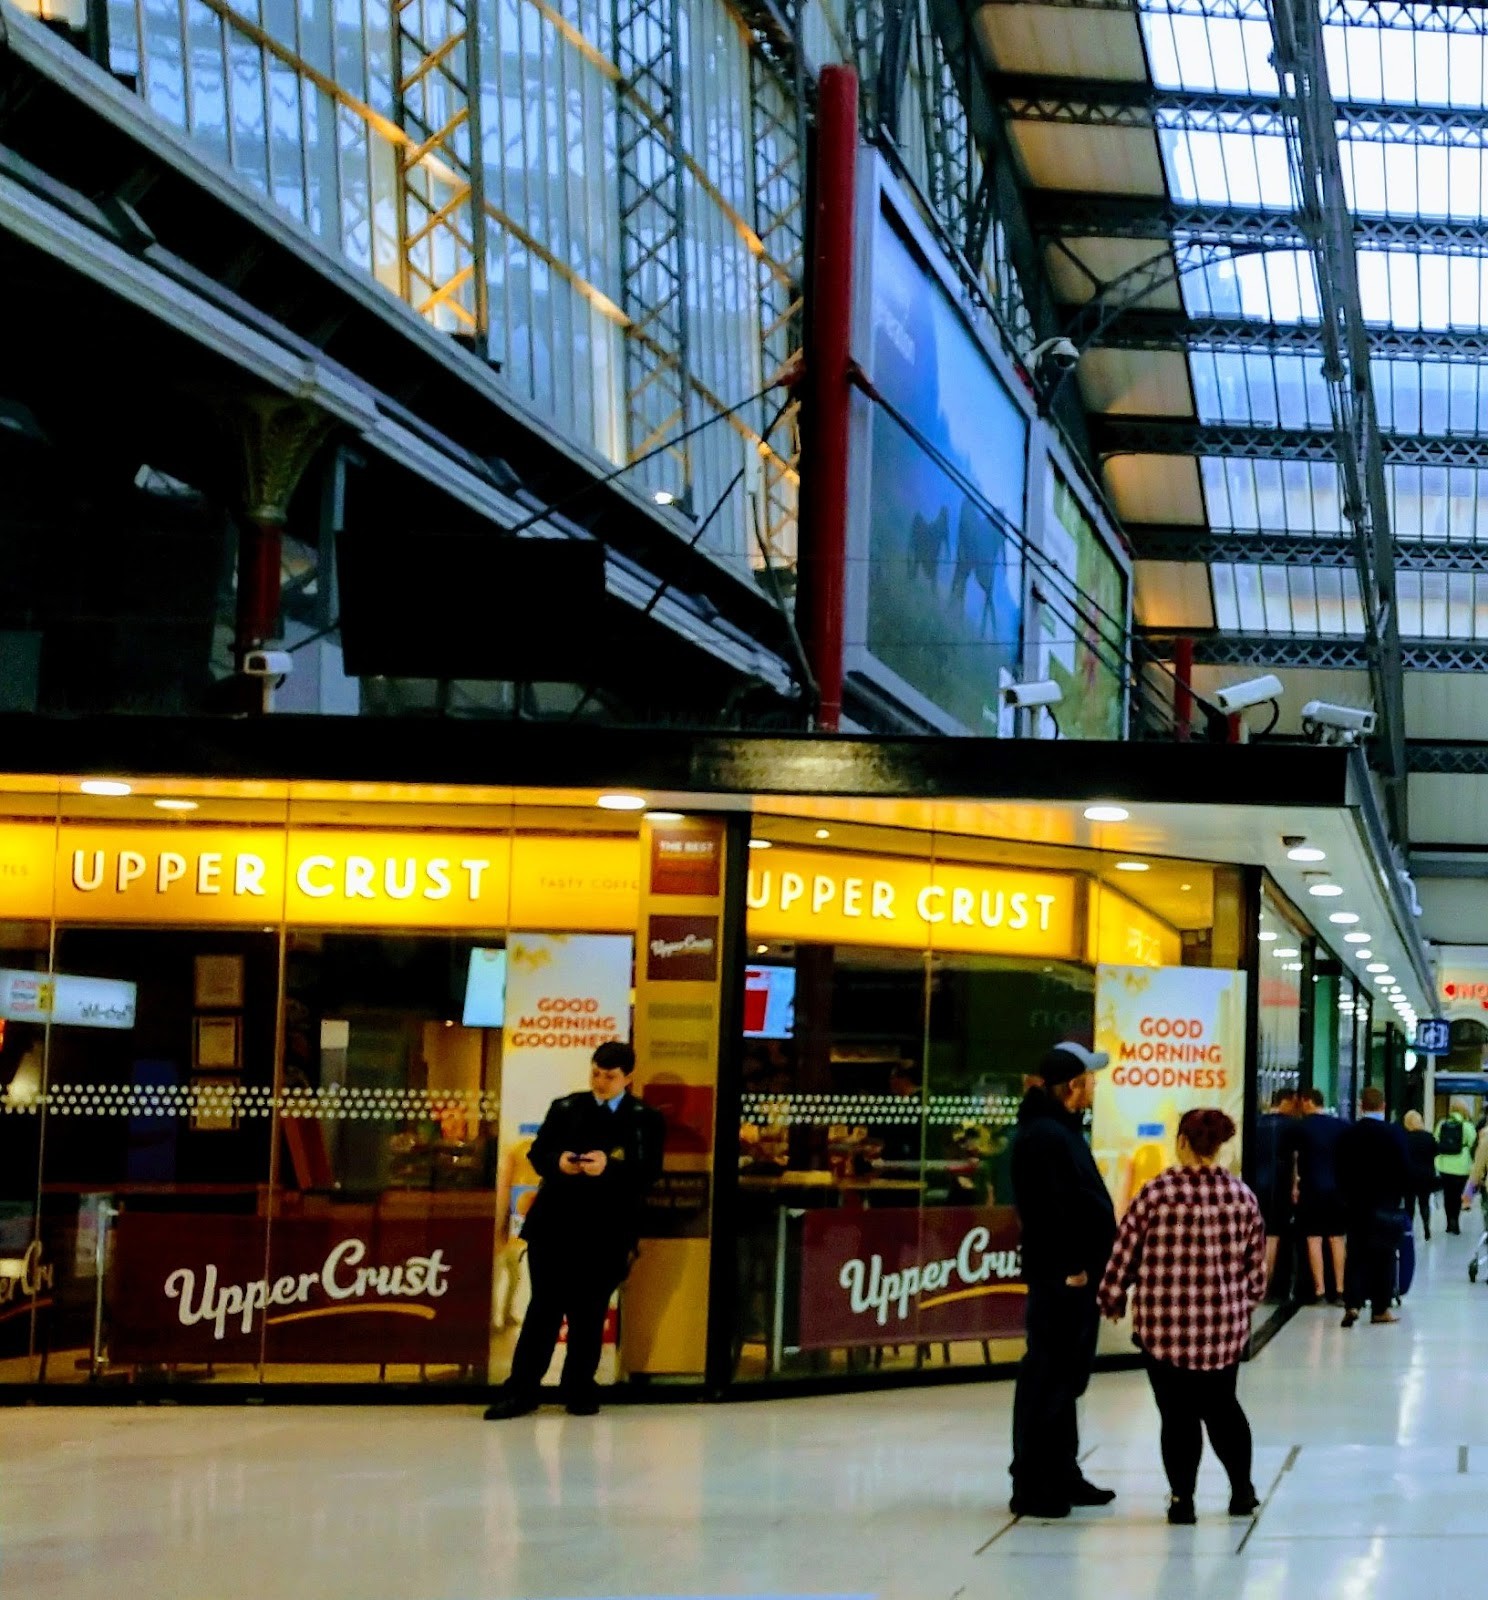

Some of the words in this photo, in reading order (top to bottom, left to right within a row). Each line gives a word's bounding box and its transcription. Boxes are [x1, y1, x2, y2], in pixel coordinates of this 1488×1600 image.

[72, 849, 267, 896] UPPER
[296, 855, 491, 901] CRUST
[747, 869, 896, 919] UPPER
[917, 885, 1056, 932] CRUST
[537, 997, 598, 1013] GOOD
[518, 1016, 616, 1031] MORNING
[1140, 1016, 1203, 1039] GOOD
[1118, 1042, 1222, 1063] MORNING
[1111, 1066, 1227, 1089] GOODNESS
[839, 1254, 957, 1326] Upper
[957, 1226, 1022, 1283] Cru
[164, 1264, 320, 1340] Upper
[321, 1238, 451, 1300] Crust
